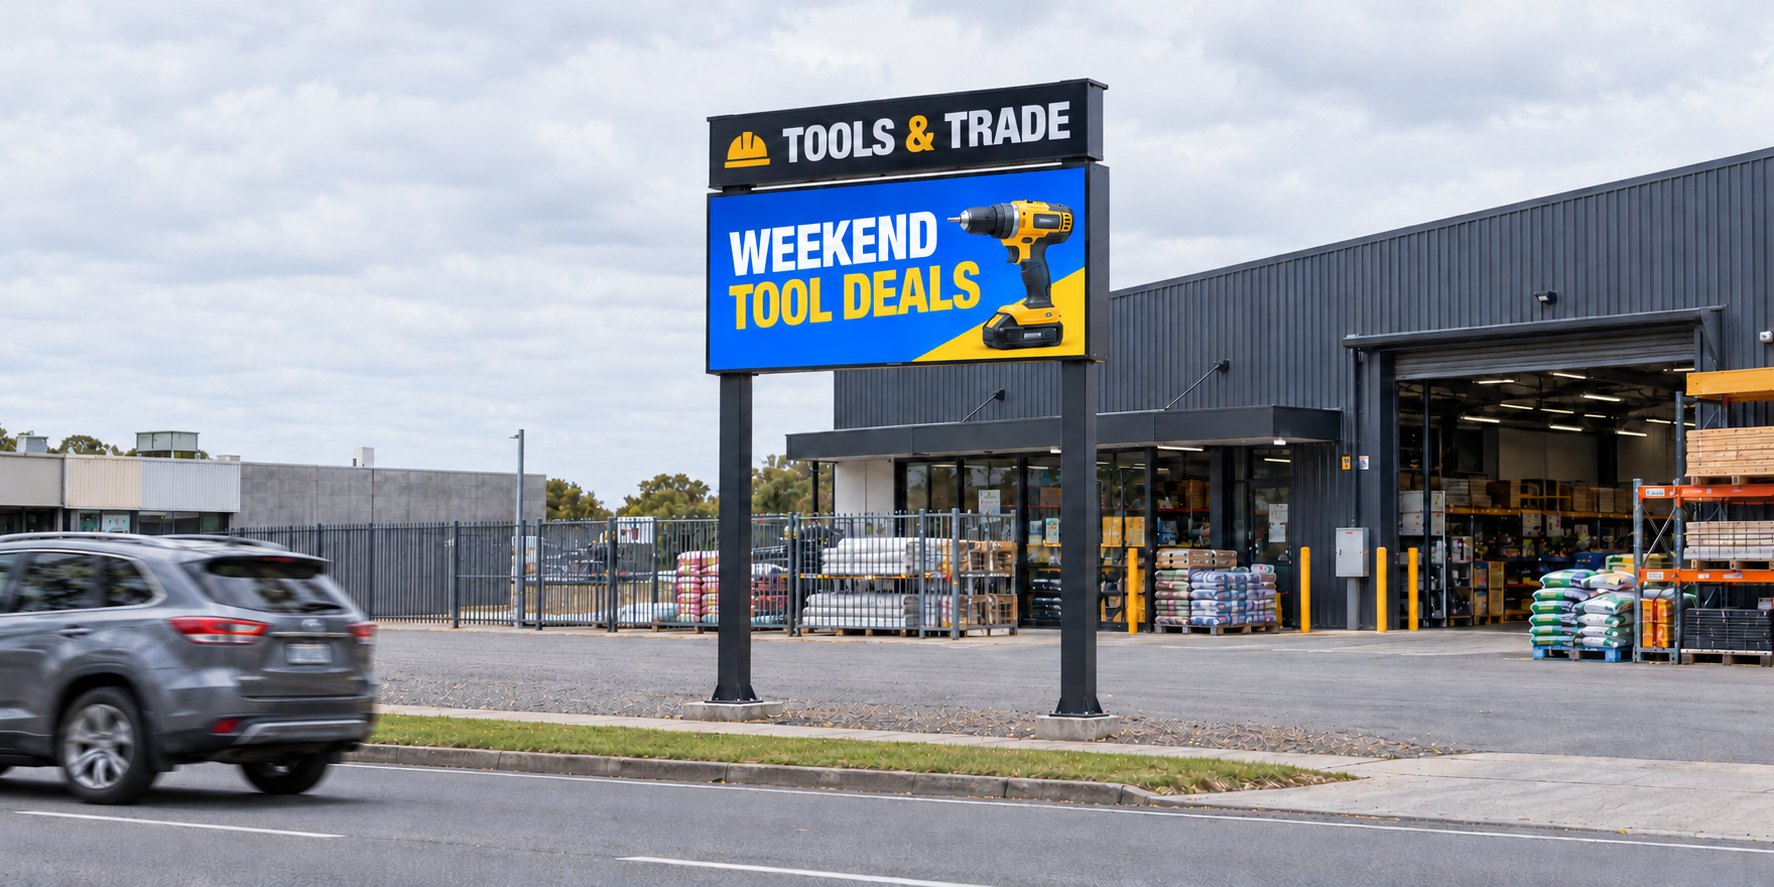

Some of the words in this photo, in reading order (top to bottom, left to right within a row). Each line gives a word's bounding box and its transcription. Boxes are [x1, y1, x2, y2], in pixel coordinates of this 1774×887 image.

[782, 118, 895, 163] TOOLS
[906, 115, 935, 152] &
[945, 102, 1070, 149] TRADE
[729, 211, 937, 276] WEEKEND
[729, 277, 832, 330] TOOL
[843, 260, 980, 320] DEALS
